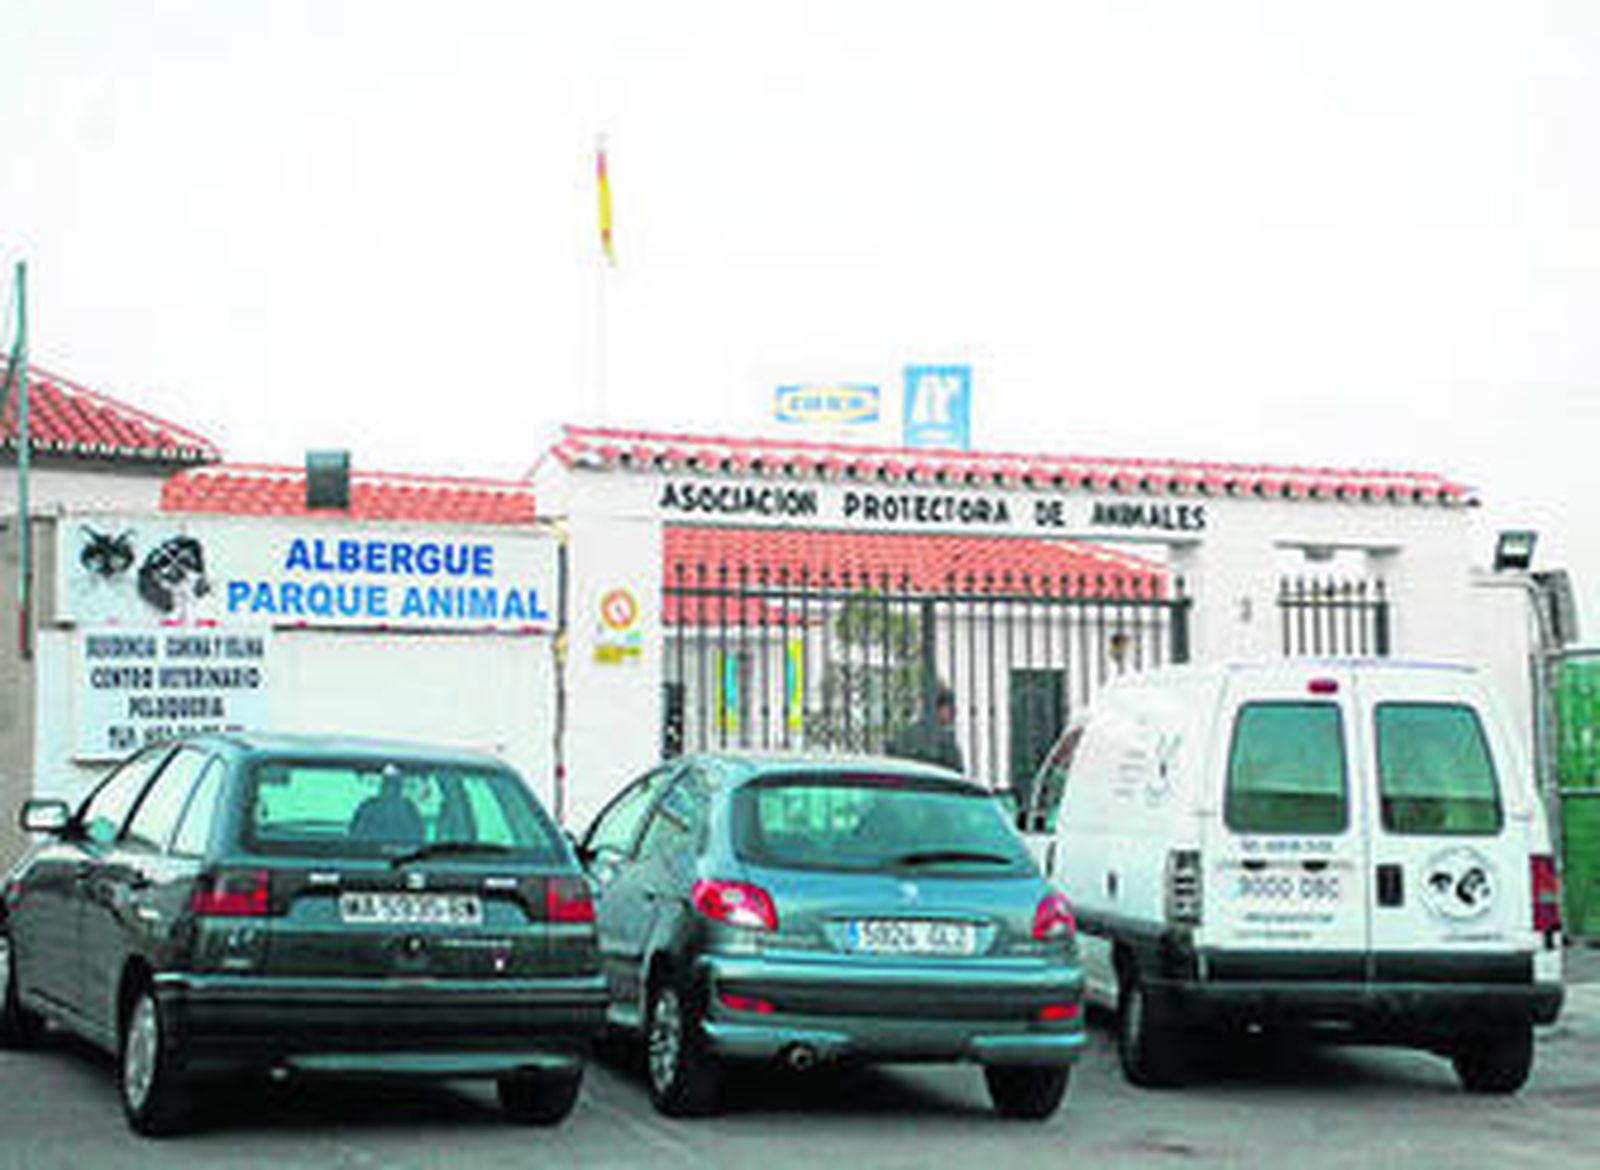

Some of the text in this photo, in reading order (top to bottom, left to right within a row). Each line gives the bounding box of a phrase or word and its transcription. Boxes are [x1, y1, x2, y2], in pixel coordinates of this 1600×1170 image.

[660, 483, 1206, 530] ASOCIACION PROTECTORA DE ANIMALES
[284, 537, 494, 576] ALBERGUE
[226, 579, 548, 620] PARQUE ANIMAL
[90, 667, 262, 689] CENTRO VETERINARIO
